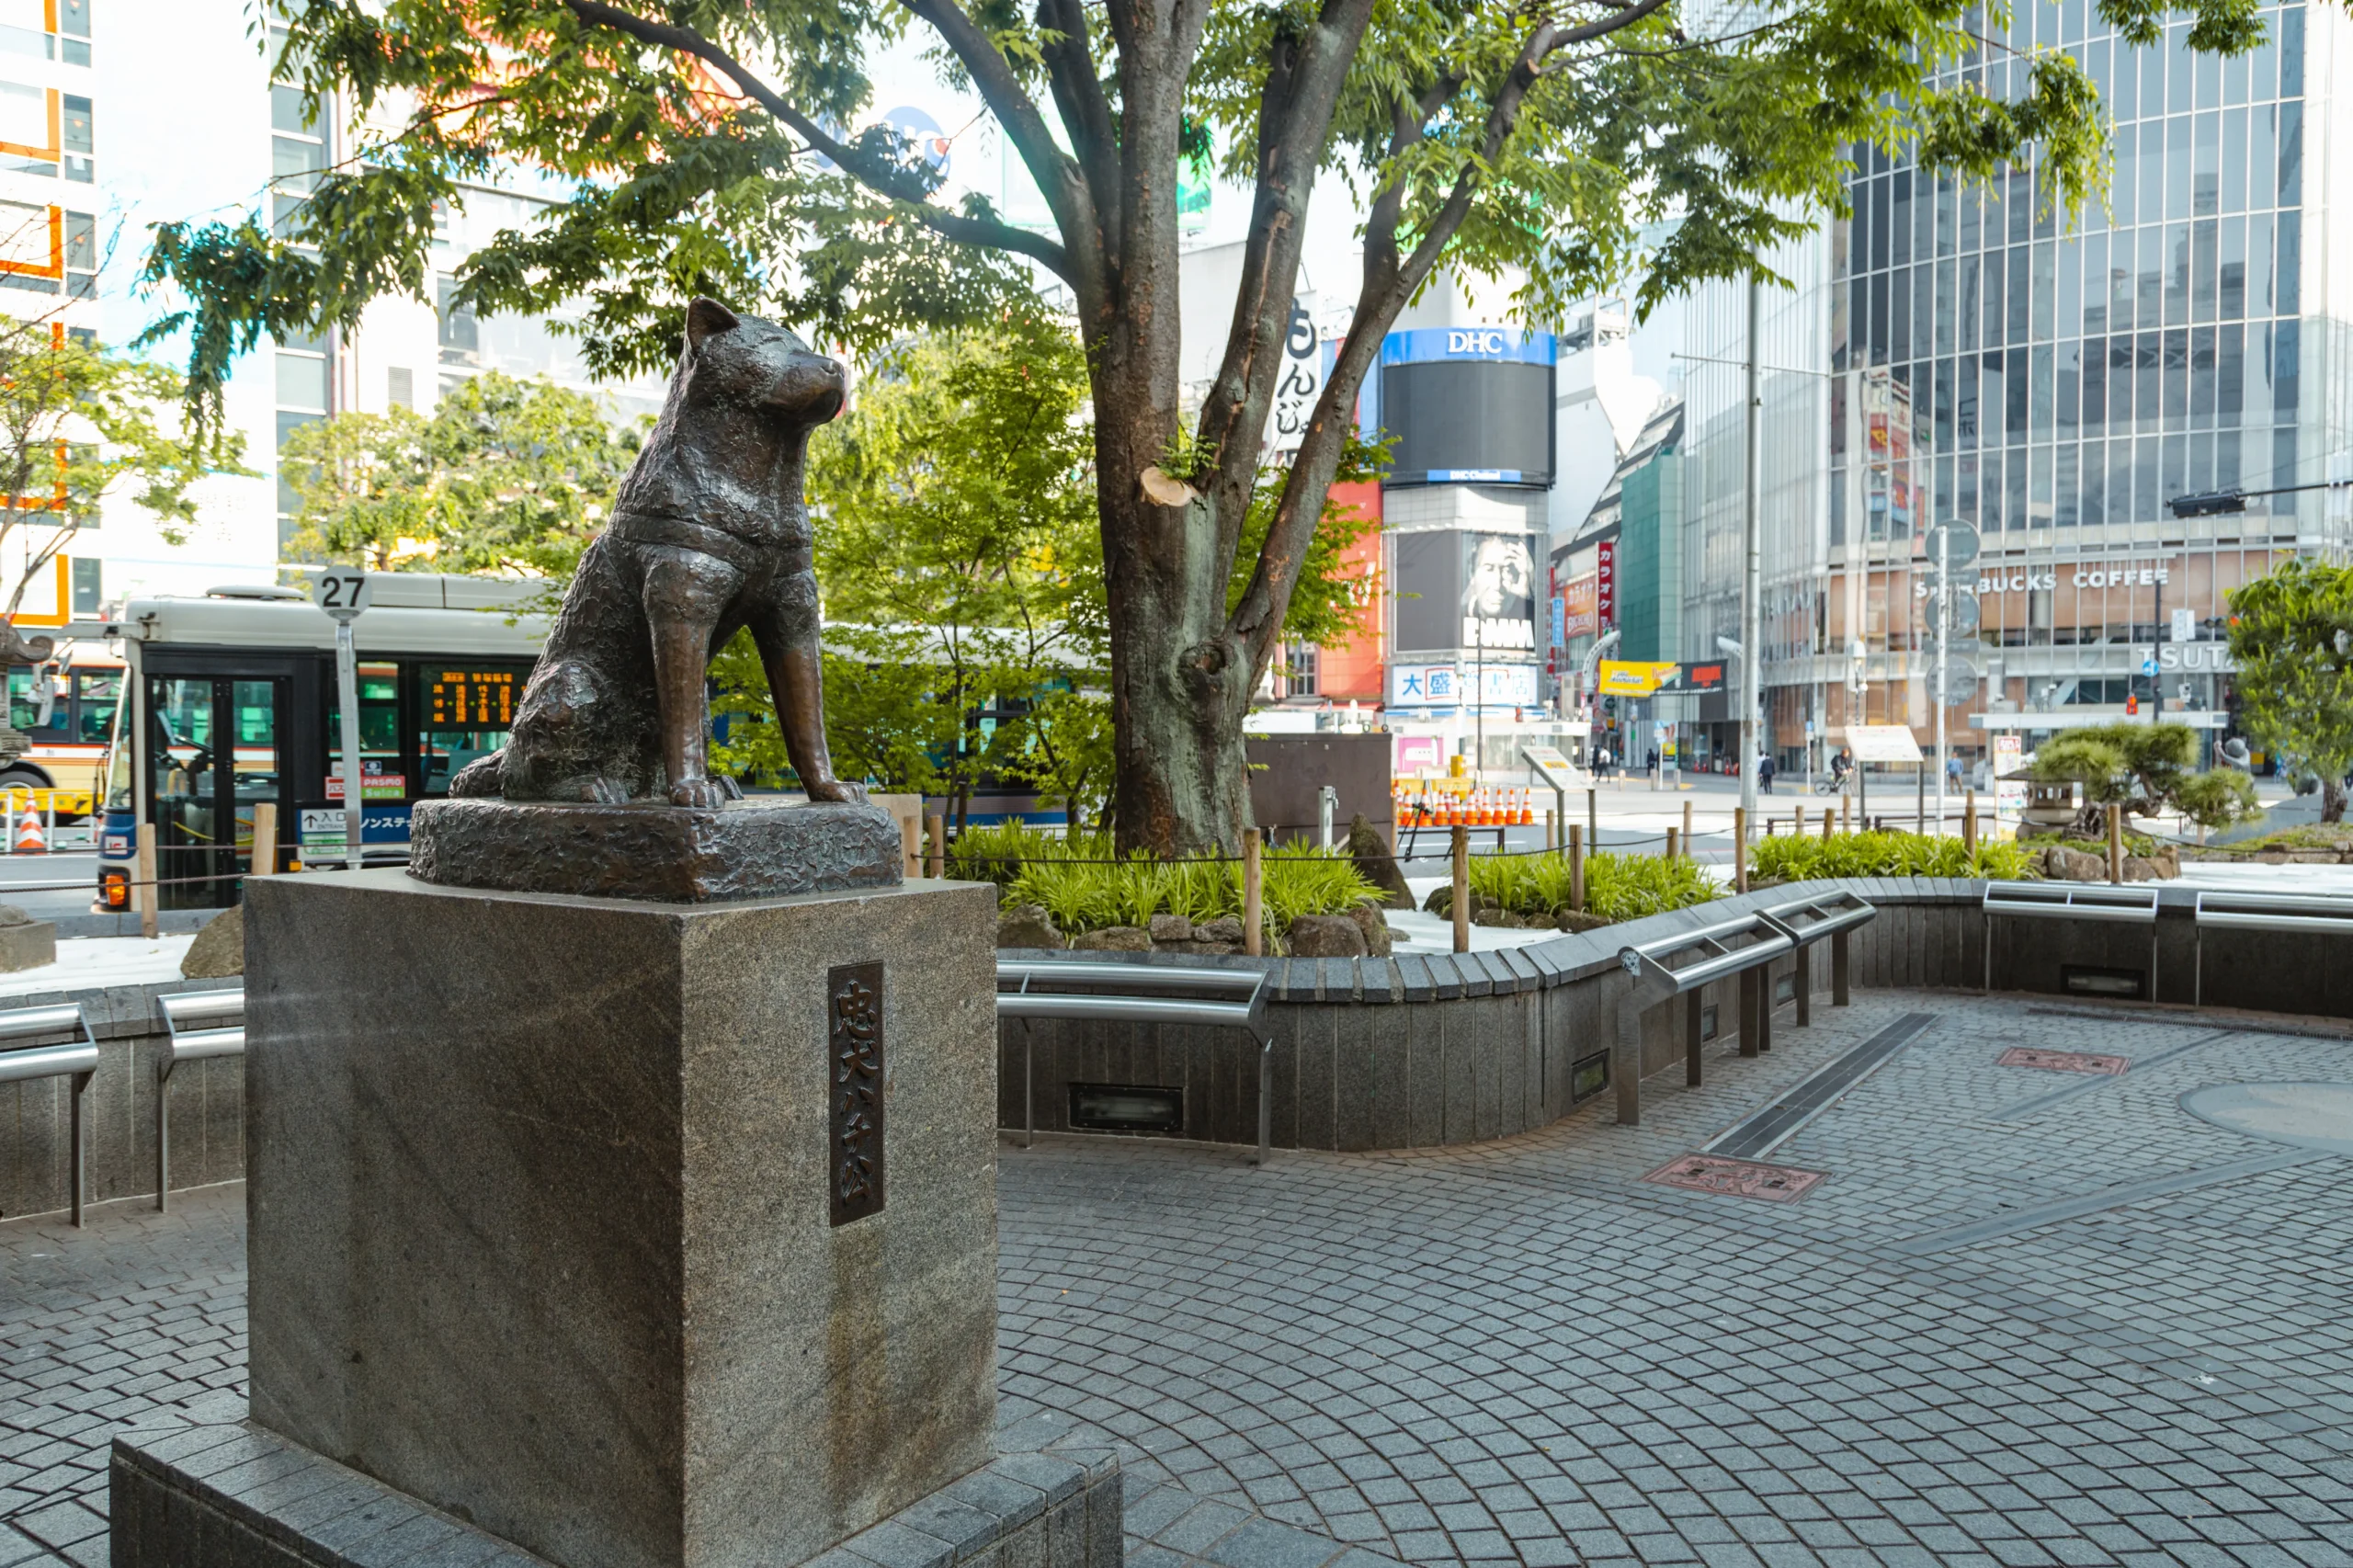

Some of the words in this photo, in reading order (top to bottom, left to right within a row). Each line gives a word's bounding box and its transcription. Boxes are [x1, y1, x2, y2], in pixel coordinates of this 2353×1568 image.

[1448, 331, 1503, 354] DHC
[322, 576, 365, 608] 27
[1915, 573, 2057, 598] SBUCKS
[2072, 568, 2169, 589] COFFEE
[364, 778, 402, 787] PASMO
[365, 789, 400, 797] Suica
[321, 812, 347, 823] 入口
[833, 980, 879, 1206] 忠犬ハチ公
